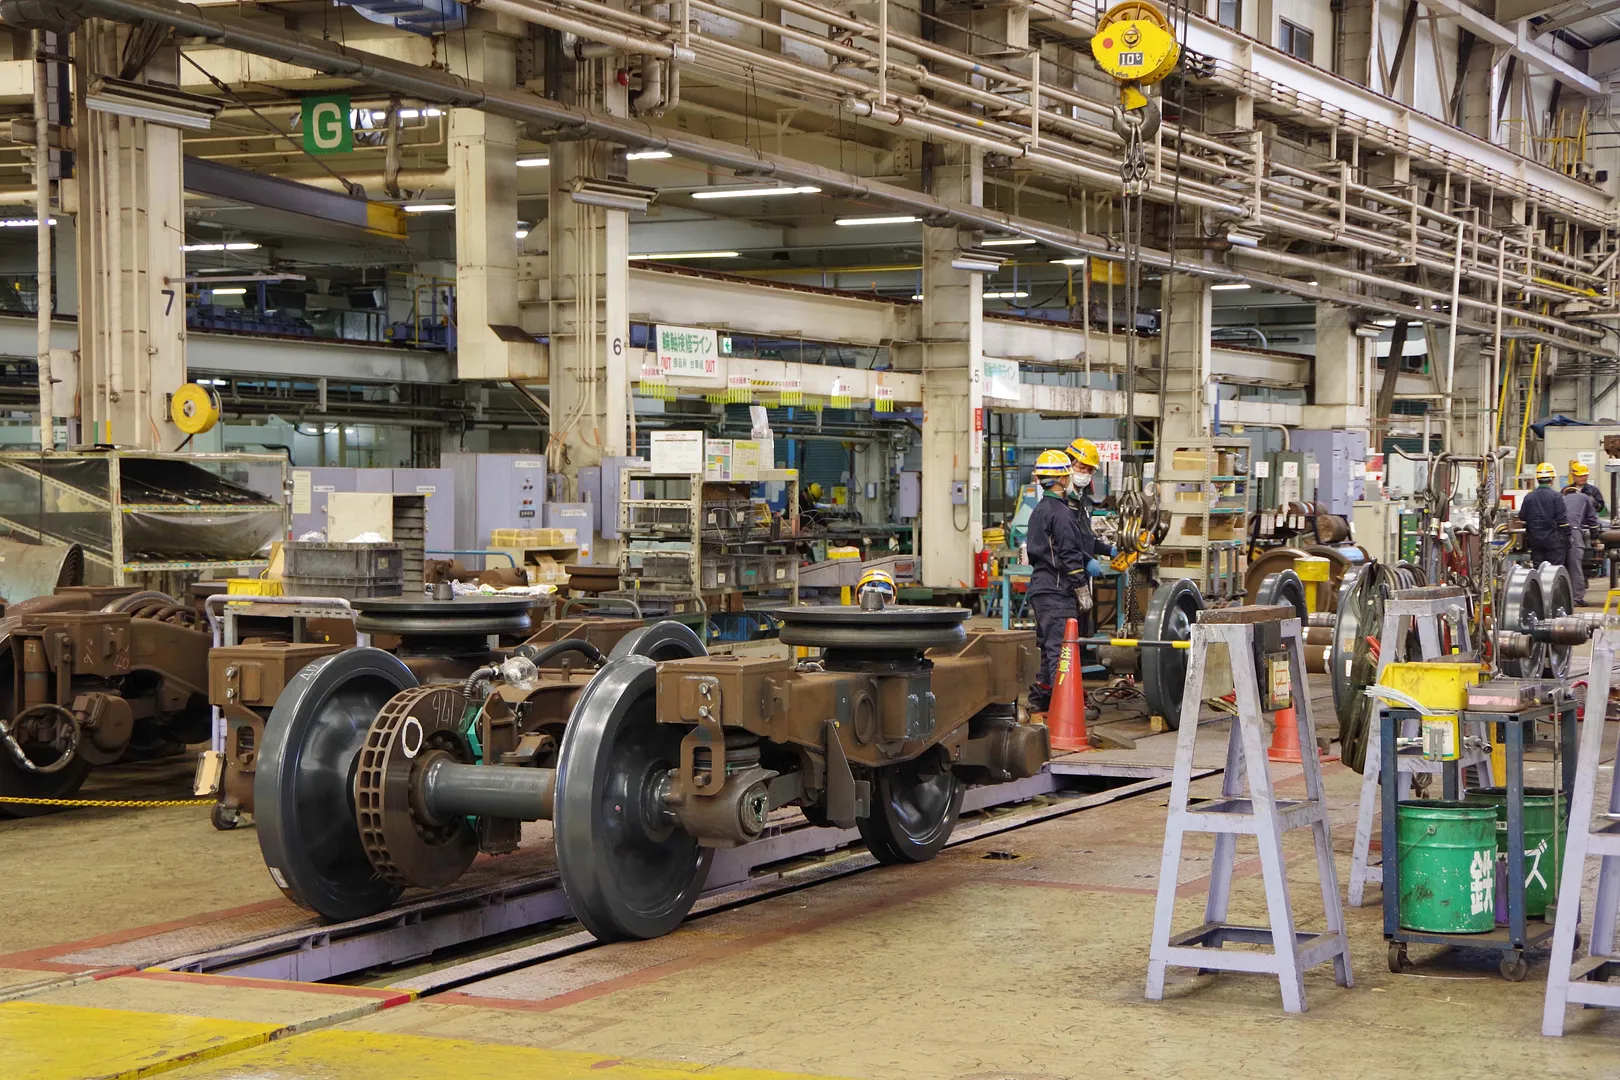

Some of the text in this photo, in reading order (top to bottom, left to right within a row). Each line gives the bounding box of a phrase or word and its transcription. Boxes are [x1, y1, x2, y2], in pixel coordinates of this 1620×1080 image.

[312, 102, 343, 149] G
[161, 289, 175, 317] 7
[612, 337, 622, 356] 6
[974, 369, 980, 384] 5
